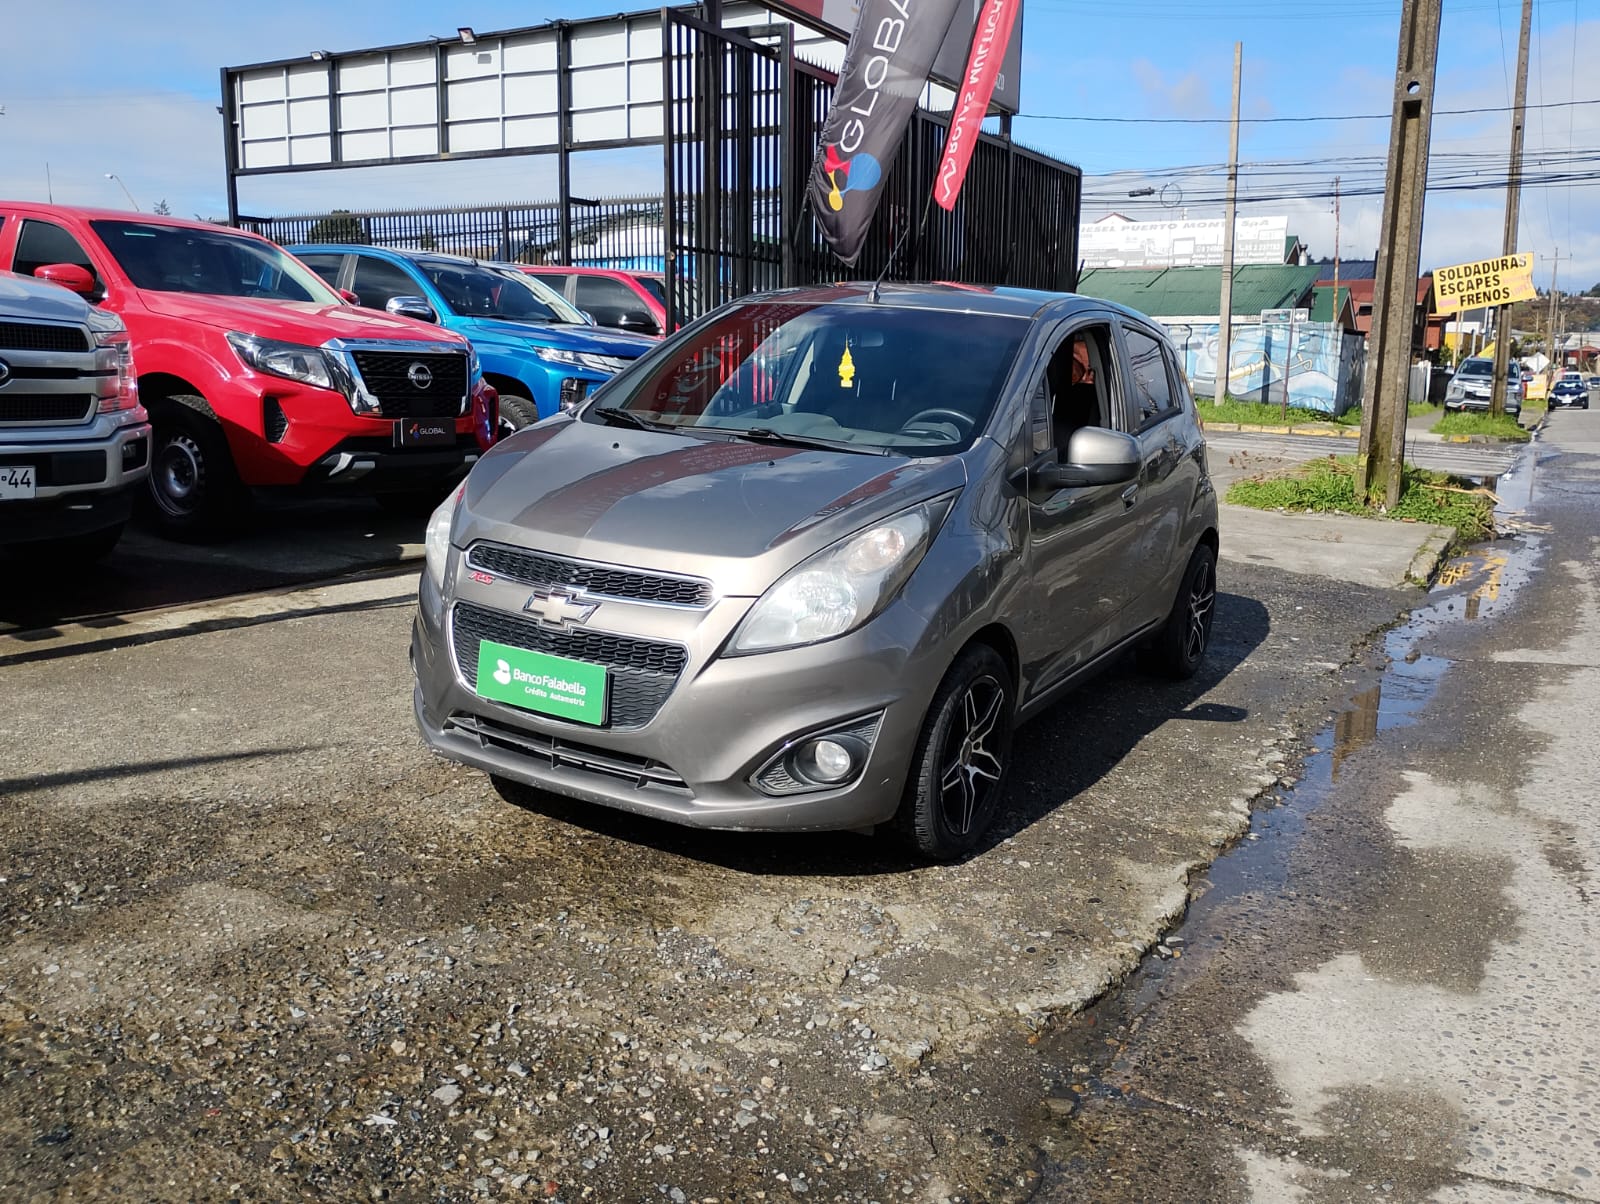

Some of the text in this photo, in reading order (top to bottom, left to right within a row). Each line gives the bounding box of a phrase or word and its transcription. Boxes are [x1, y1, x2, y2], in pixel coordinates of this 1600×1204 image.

[1081, 225, 1116, 233] IESEL
[1121, 223, 1178, 232] PUERTO
[1182, 221, 1226, 229] MONT
[1438, 256, 1527, 282] SOLDADURAS
[1440, 274, 1500, 296] ESCAPES
[1460, 287, 1510, 307] FRENOS
[419, 427, 446, 435] GLOBAL
